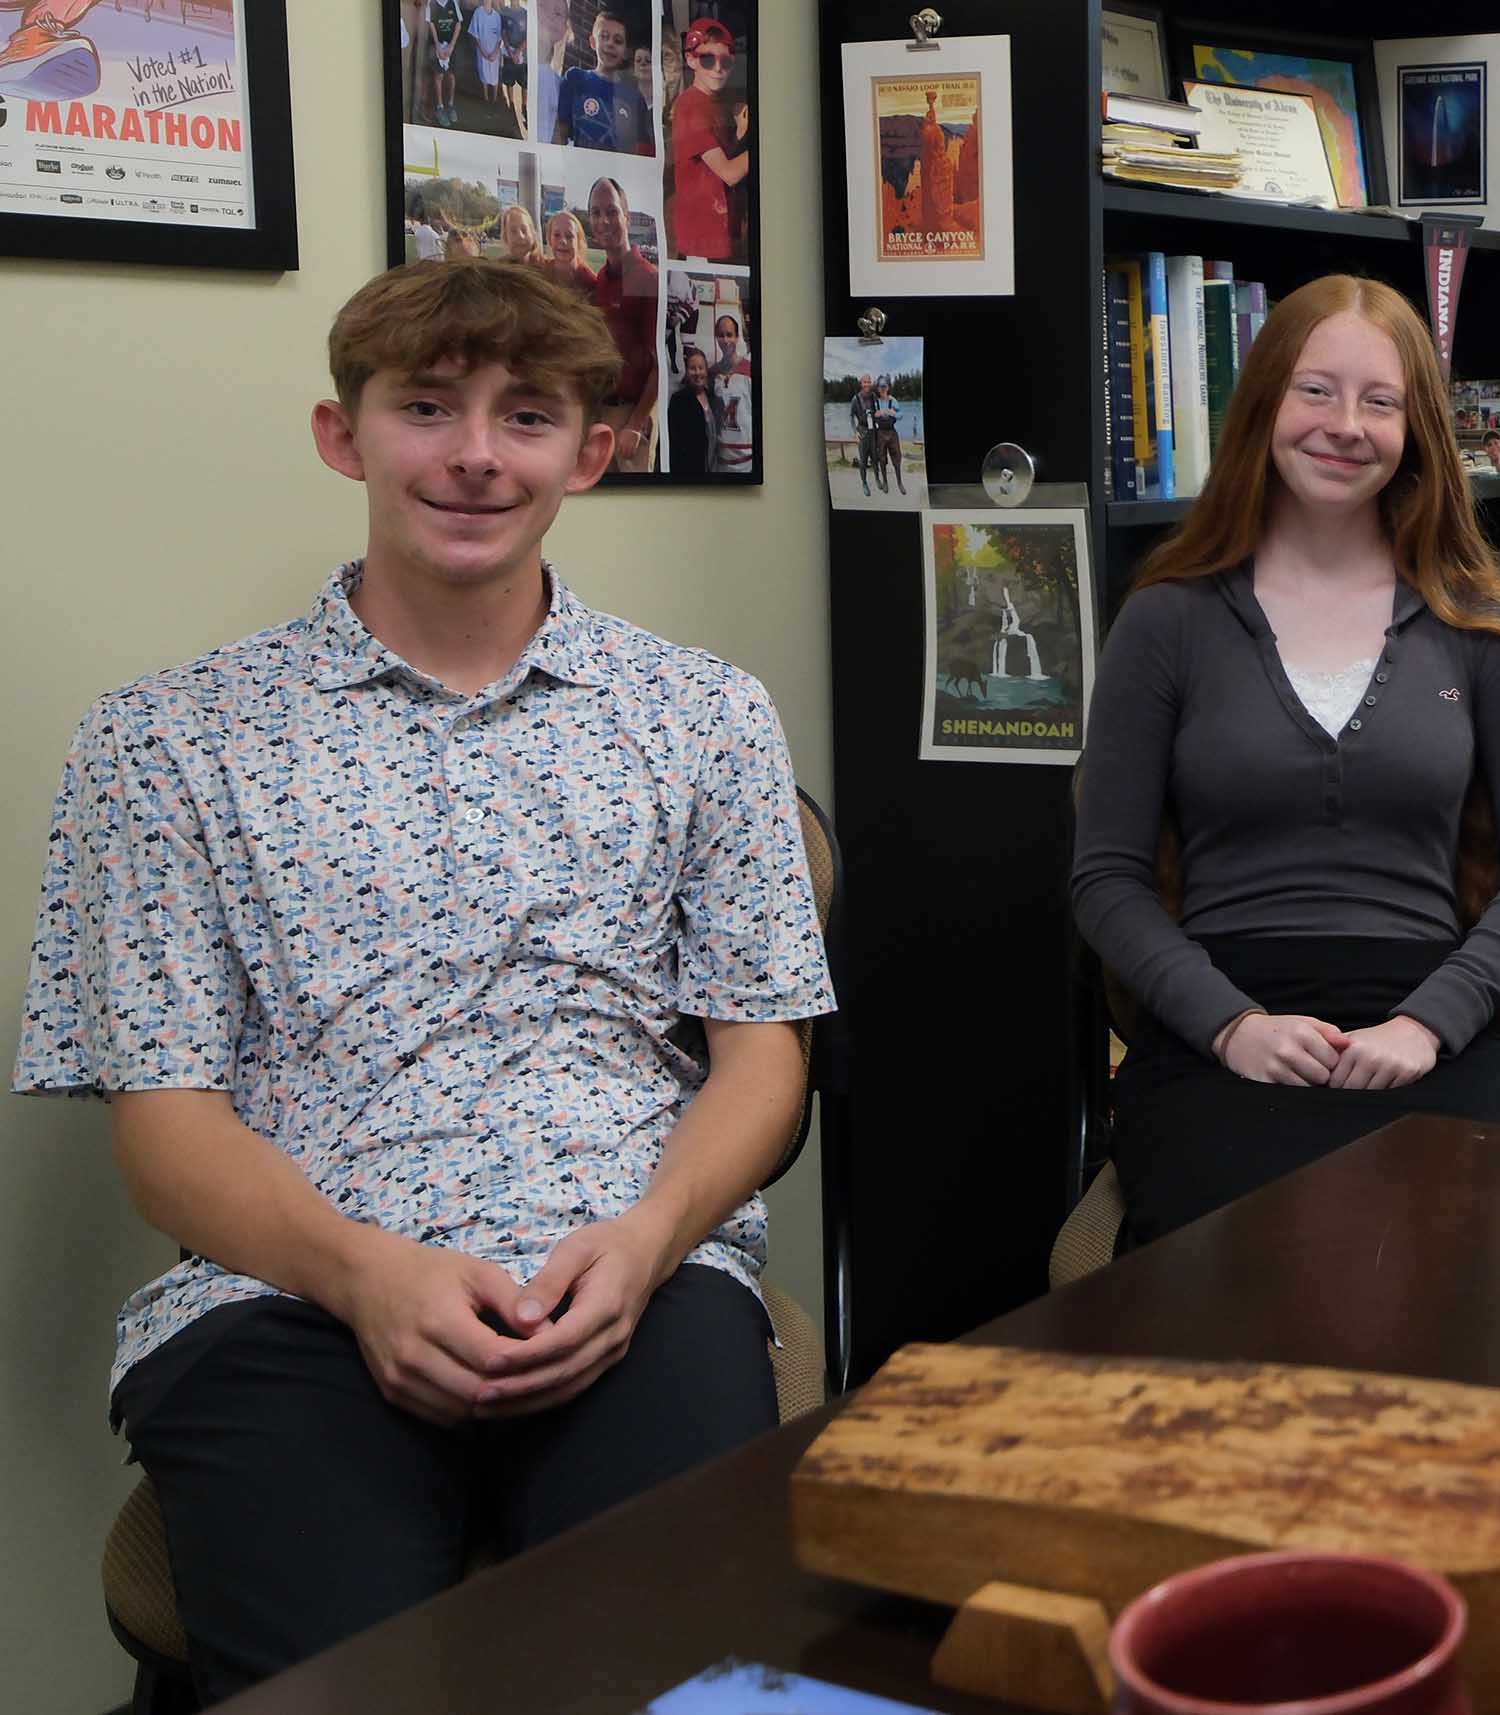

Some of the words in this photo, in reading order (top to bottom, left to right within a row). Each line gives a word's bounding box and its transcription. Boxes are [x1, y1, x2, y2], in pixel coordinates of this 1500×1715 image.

[126, 51, 177, 83] Voted
[179, 45, 208, 69] #1
[131, 86, 151, 107] in
[152, 82, 177, 103] the
[177, 58, 235, 101] Nation!
[25, 100, 242, 152] MARATHON
[222, 207, 237, 216] TQL
[886, 242, 923, 251] NATIONAL
[943, 241, 977, 249] PARK
[888, 232, 923, 243] BRYCE
[926, 232, 975, 242] CANYON
[1438, 248, 1453, 336] INDIANA
[1159, 319, 1169, 379] Investment
[1104, 379, 1112, 445] Valuation
[942, 719, 1074, 737] SHENANDOAH
